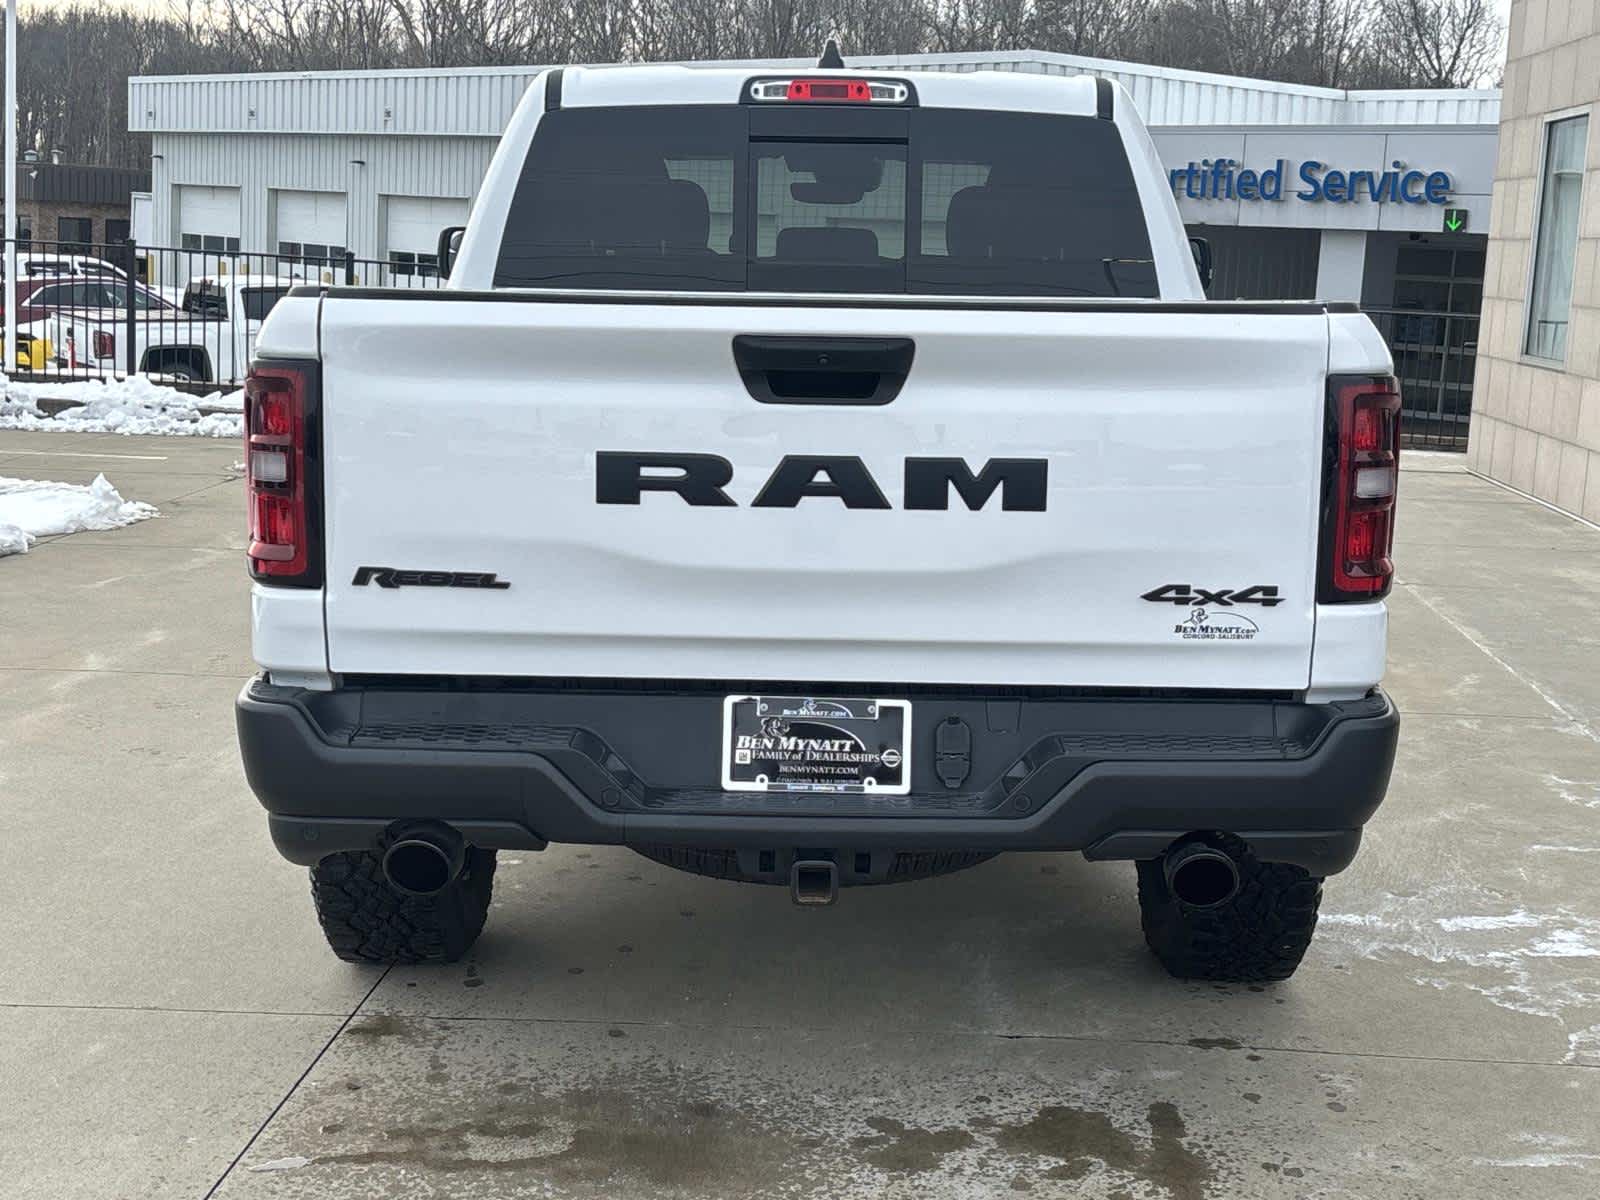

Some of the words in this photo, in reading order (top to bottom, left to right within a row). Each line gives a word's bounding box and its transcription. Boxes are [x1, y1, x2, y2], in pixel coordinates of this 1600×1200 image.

[1298, 160, 1452, 203] Service
[596, 451, 1049, 512] RAM
[352, 566, 511, 589] REBEL
[1175, 624, 1197, 633] BEN
[735, 736, 774, 750] BEN
[778, 737, 855, 752] MYNATT
[751, 752, 791, 761] FAMILY
[792, 752, 802, 761] of
[806, 752, 880, 763] DEALERSHIPS
[779, 765, 859, 775] BENMYNATT.COM
